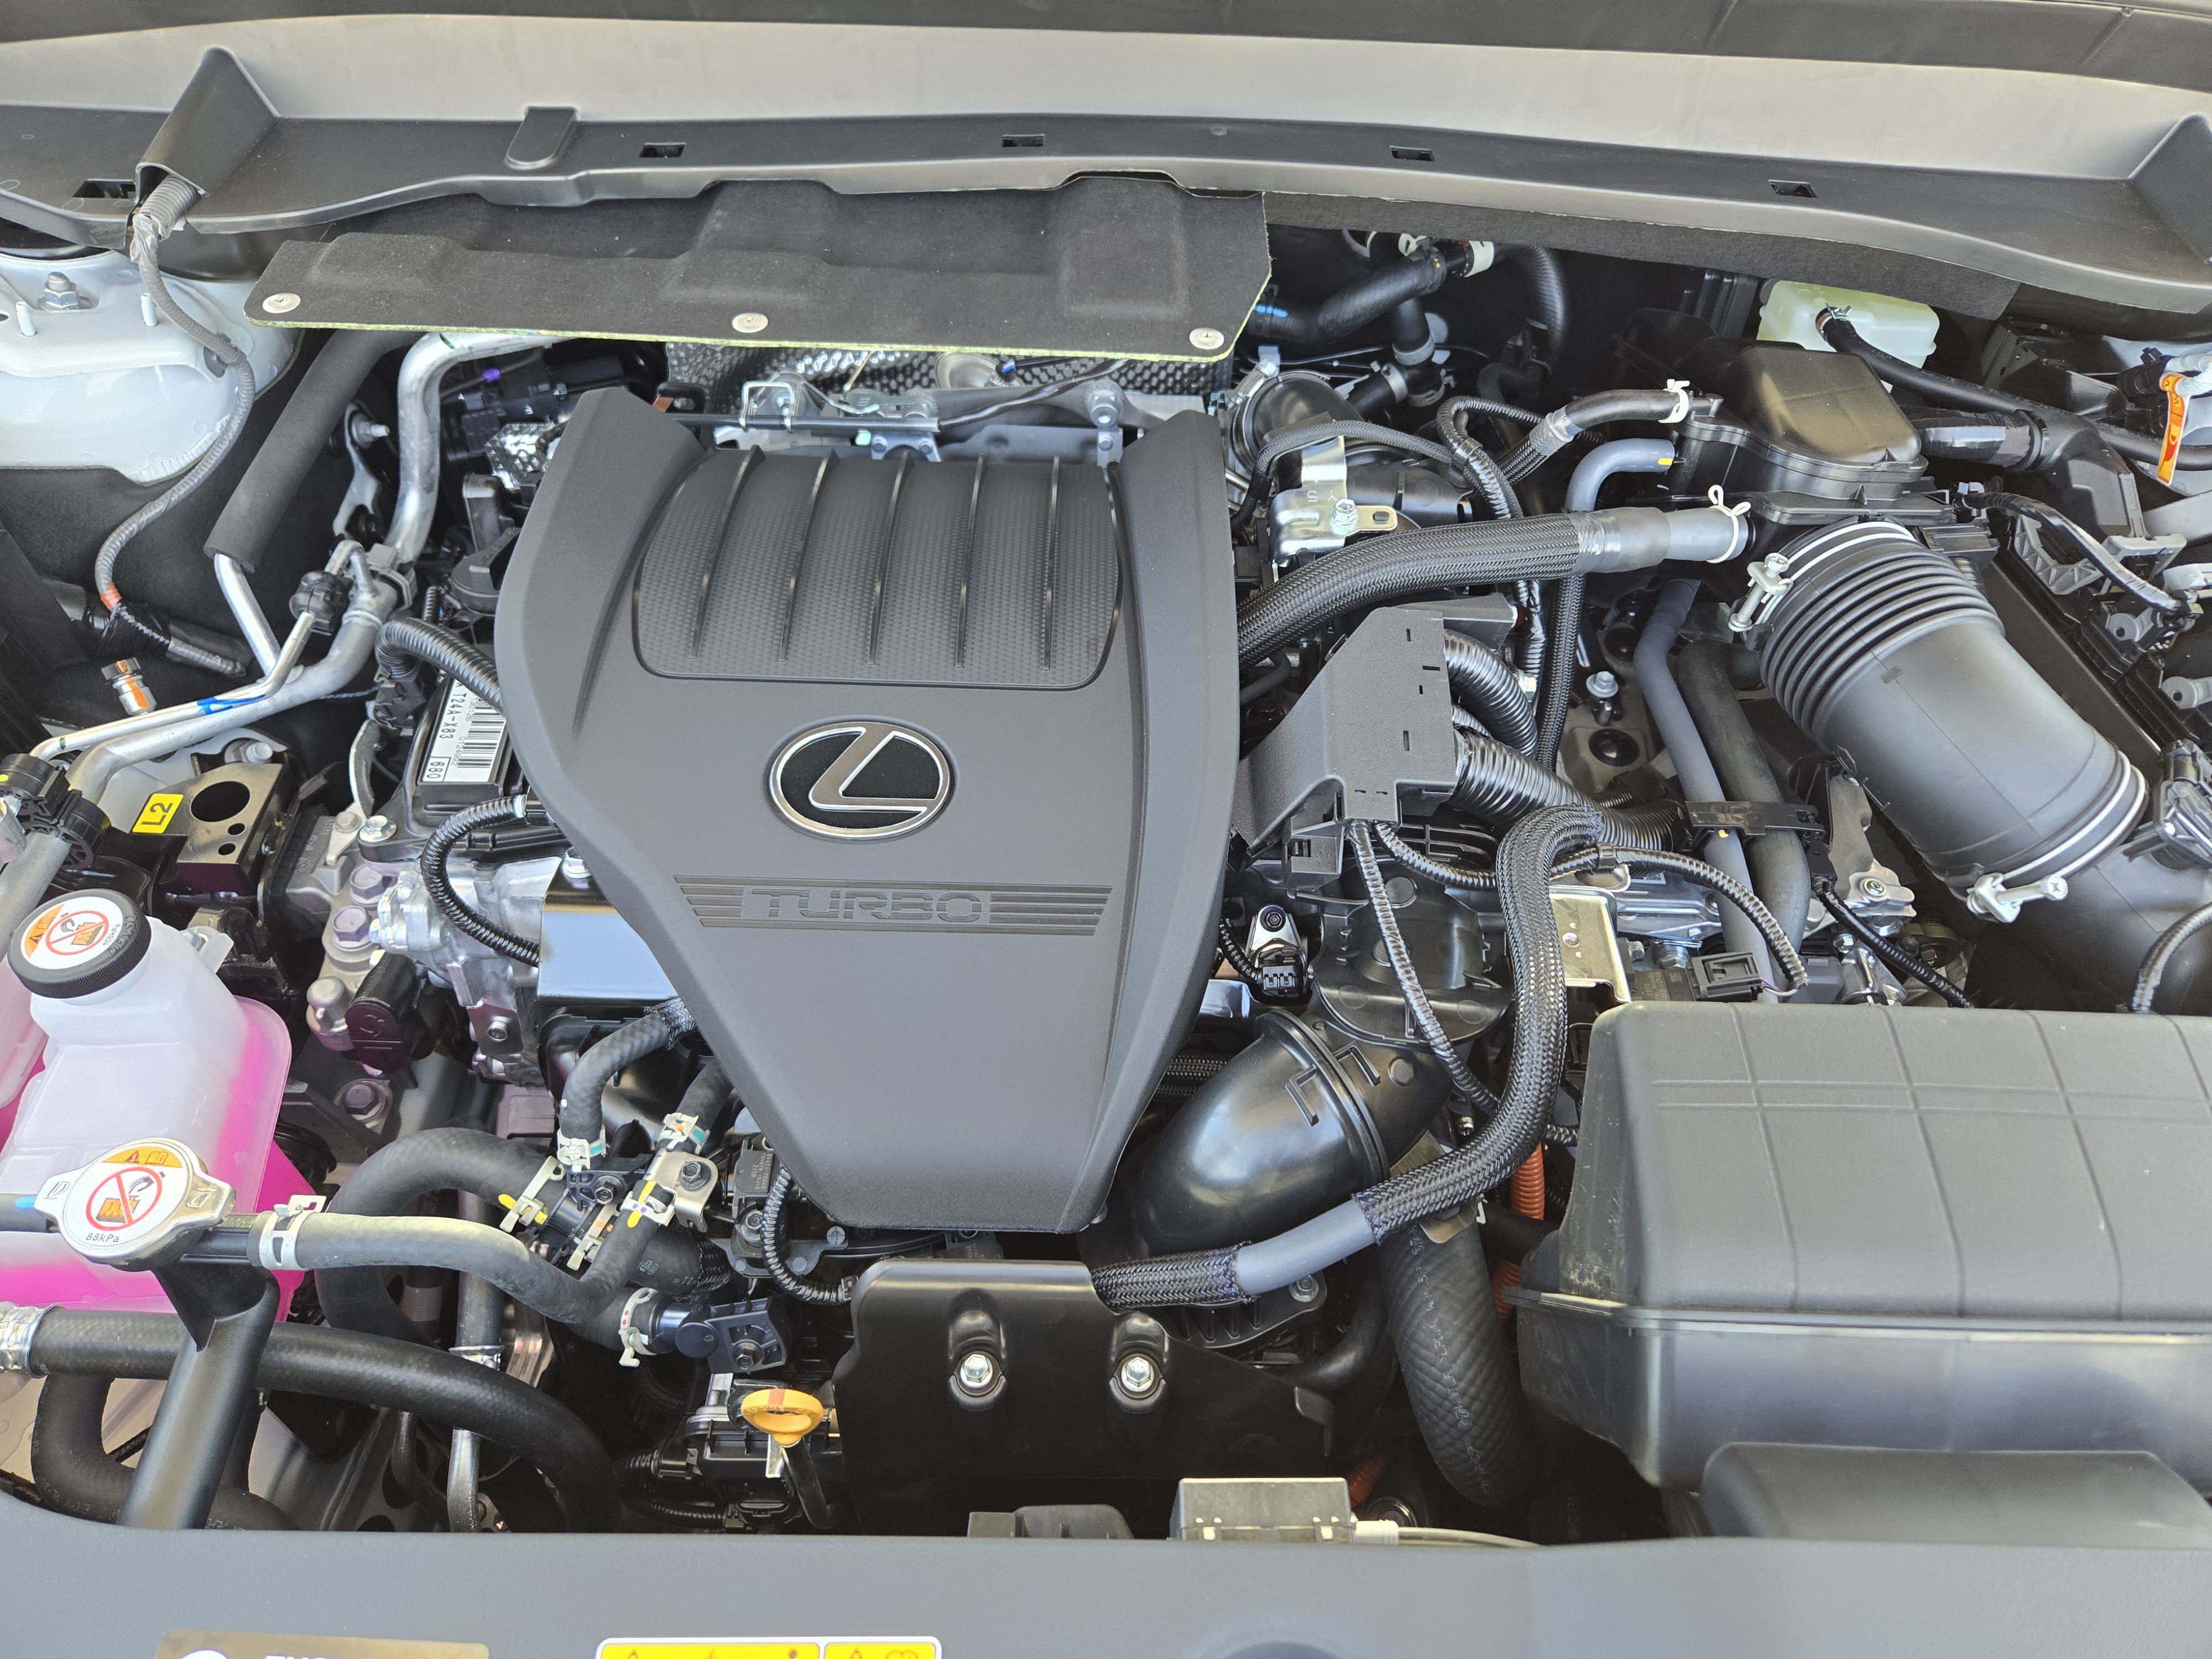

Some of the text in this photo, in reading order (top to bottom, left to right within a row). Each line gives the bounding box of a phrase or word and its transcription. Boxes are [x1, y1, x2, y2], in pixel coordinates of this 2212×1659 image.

[439, 693, 467, 739] T24A-X83
[465, 696, 478, 722] 130126
[426, 761, 445, 779] 680
[140, 802, 174, 826] L2
[751, 887, 983, 923] TURBO
[102, 924, 121, 946] 108kPa
[107, 915, 137, 958] DENSO
[758, 1152, 766, 1171] TOYOTA
[86, 1233, 119, 1243] 88kPa
